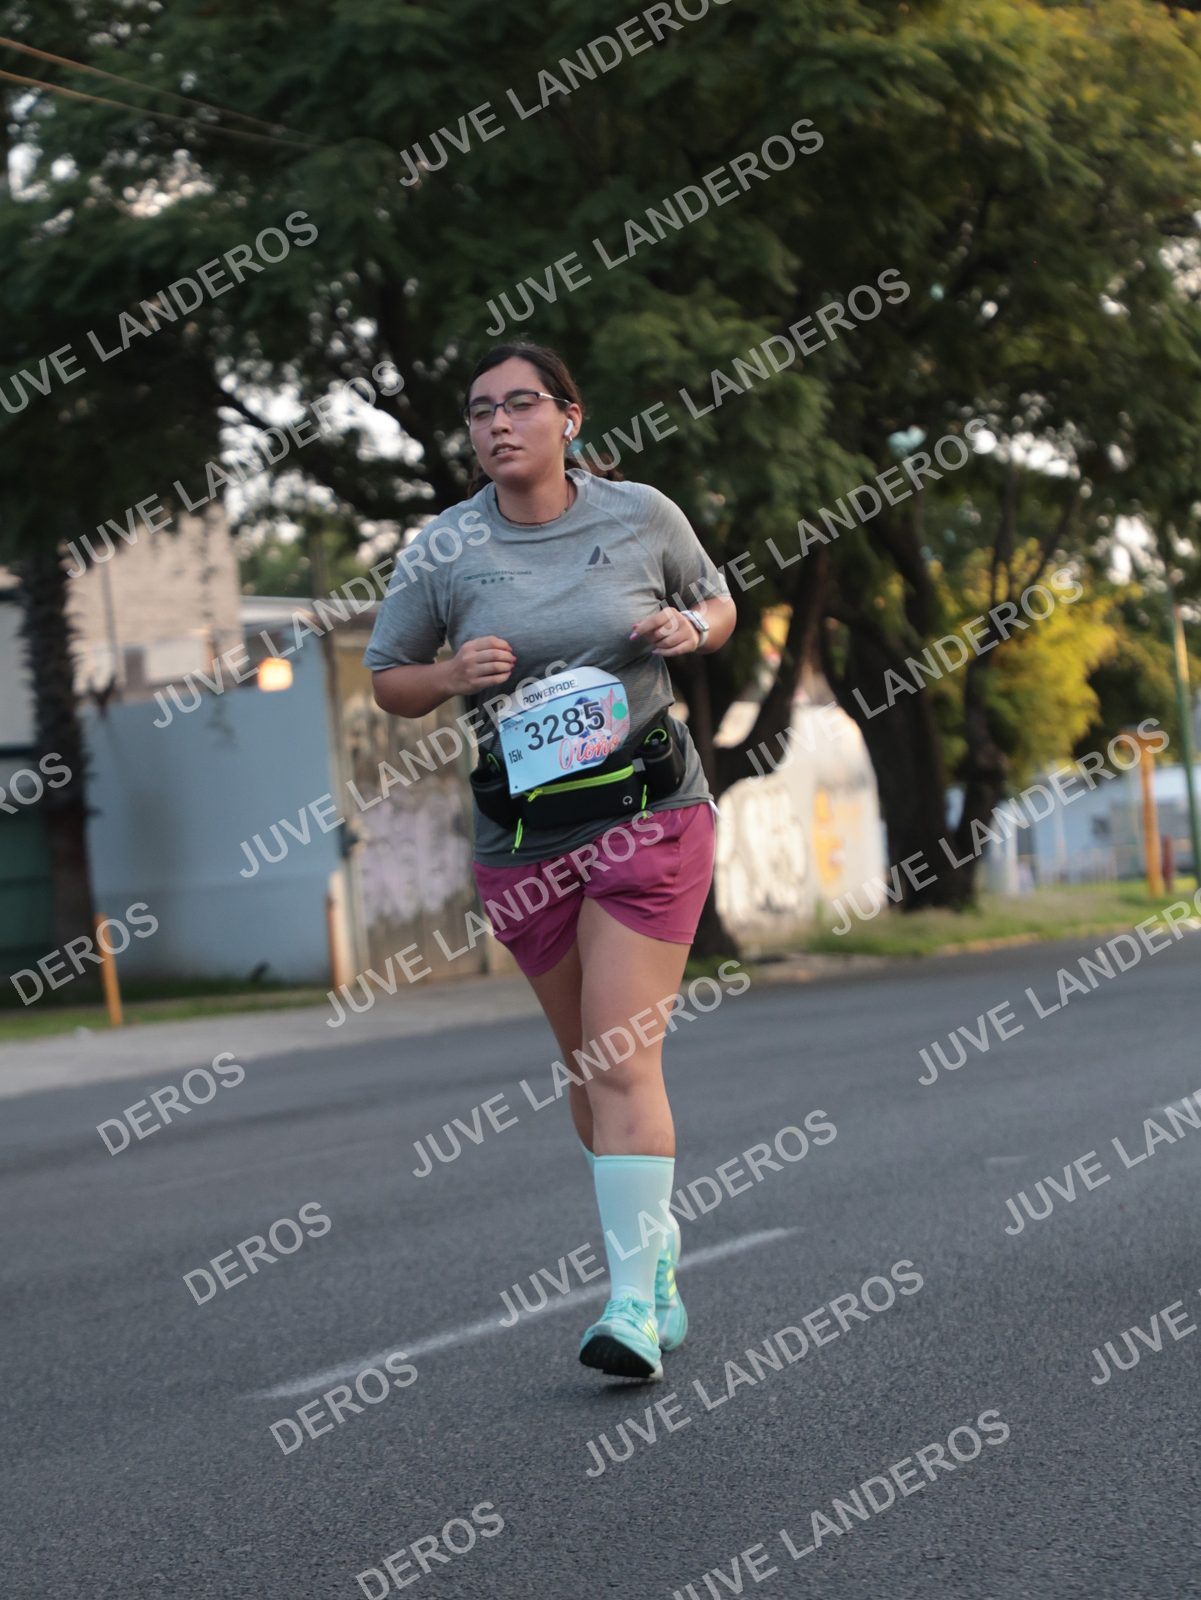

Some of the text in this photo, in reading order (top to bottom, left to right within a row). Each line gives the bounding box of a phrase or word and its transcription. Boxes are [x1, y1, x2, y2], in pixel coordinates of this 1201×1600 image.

[522, 679, 577, 705] POWERADE
[524, 701, 605, 751] 3285
[508, 749, 524, 764] 15k
